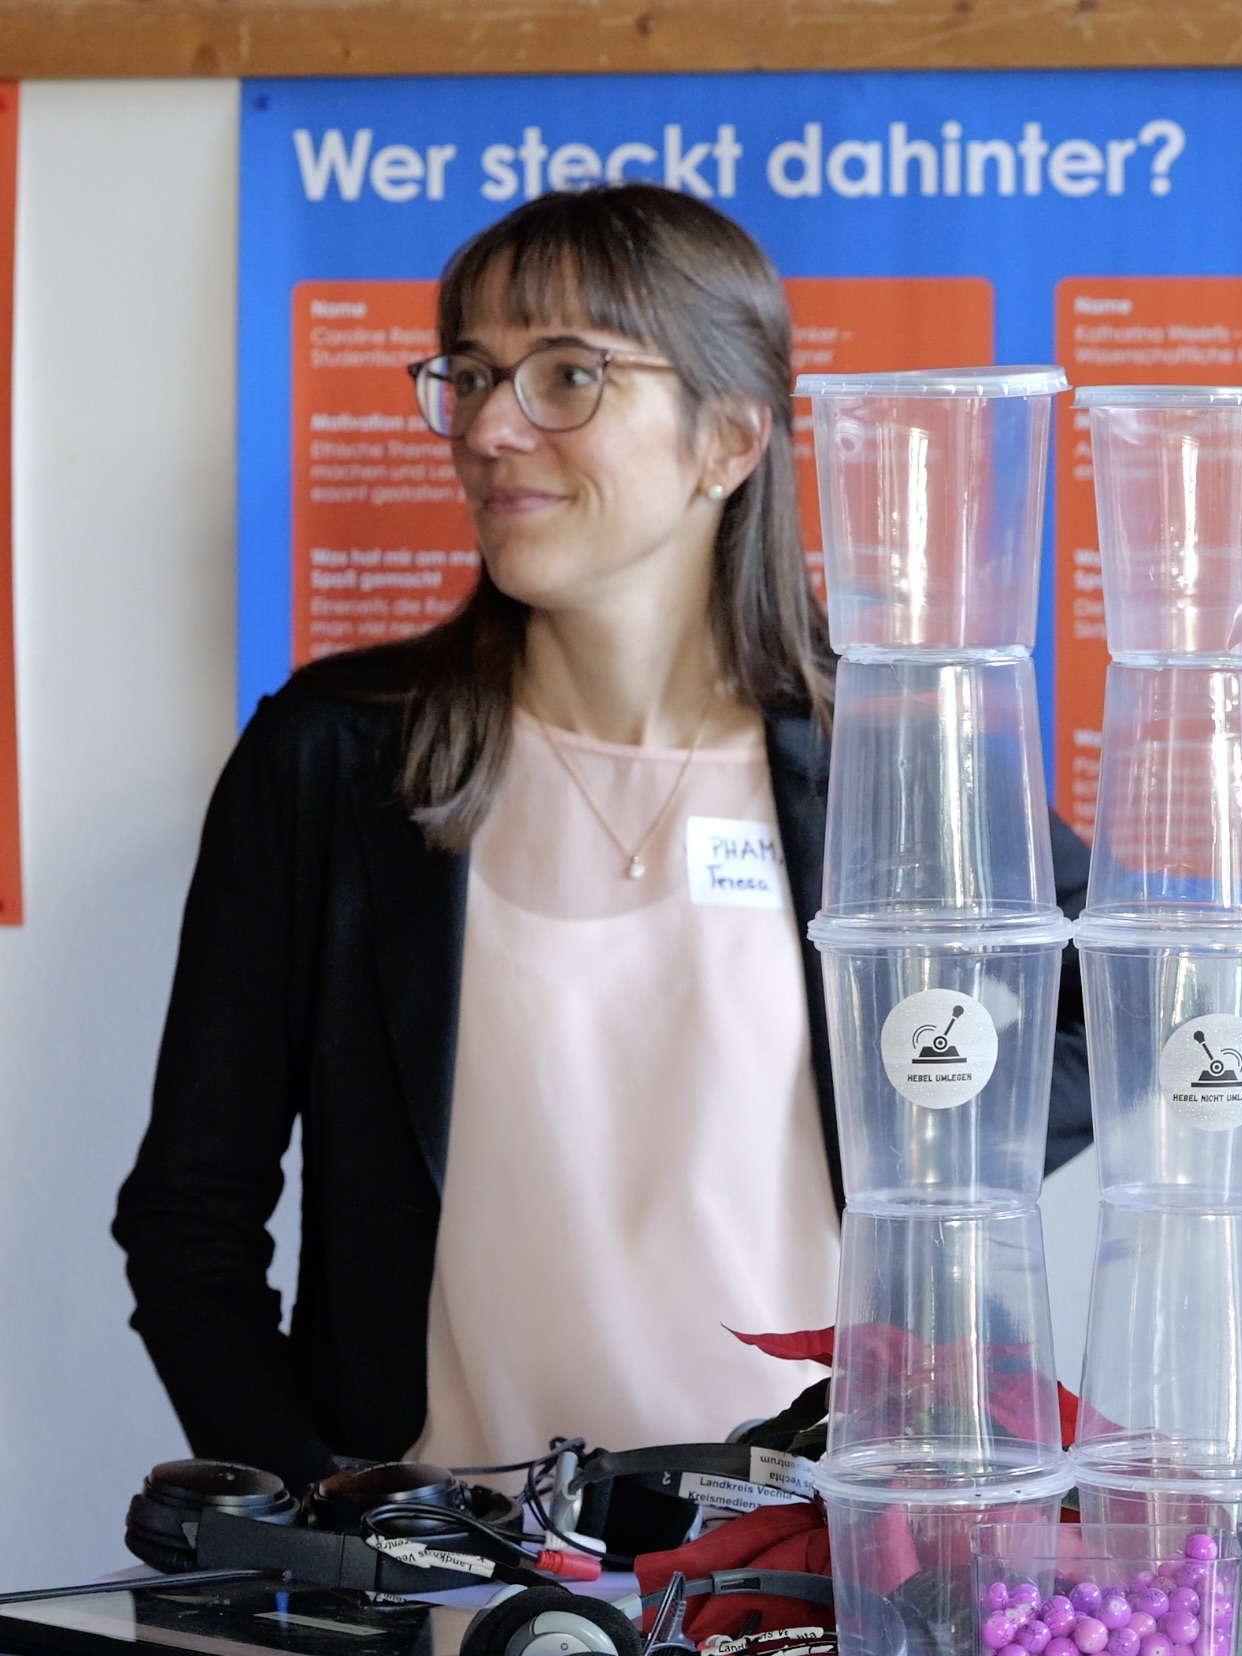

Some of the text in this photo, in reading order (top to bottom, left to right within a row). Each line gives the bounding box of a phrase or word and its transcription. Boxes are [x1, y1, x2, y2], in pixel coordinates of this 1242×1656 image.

[293, 118, 1186, 201] Wer steckt dahinter?
[311, 300, 367, 318] Name
[1074, 297, 1132, 315] Name
[1075, 347, 1235, 364] Wissenschaftliche
[311, 549, 348, 566] Was
[351, 549, 381, 566] hat
[710, 836, 777, 861] PHAM
[907, 1073, 972, 1083] HEBEL UMLEGEN
[1172, 1093, 1198, 1102] HEBEL
[1200, 1094, 1224, 1103] NICHT
[700, 1477, 754, 1493] Landkreis
[757, 1486, 792, 1500] Vechta
[769, 1472, 802, 1488] Vechta
[688, 1490, 763, 1510] Kreismedien
